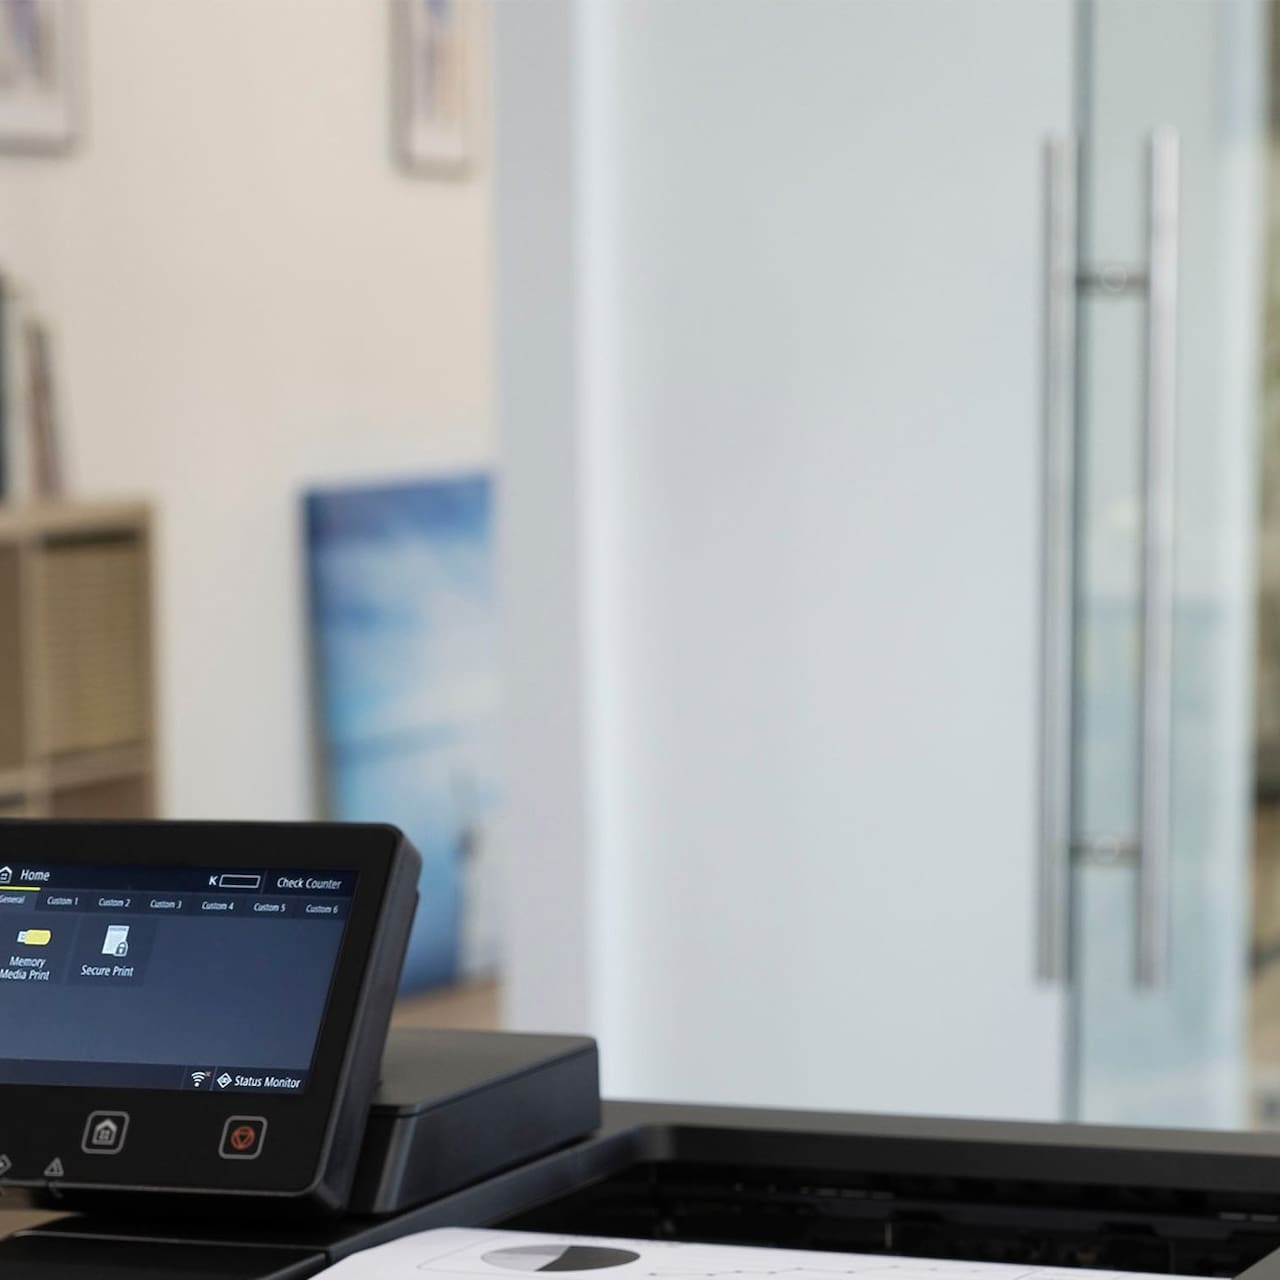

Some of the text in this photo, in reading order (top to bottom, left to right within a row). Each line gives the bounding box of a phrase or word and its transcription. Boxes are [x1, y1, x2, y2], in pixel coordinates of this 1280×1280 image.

[20, 869, 50, 882] Home
[276, 877, 342, 890] Check Counter
[47, 896, 72, 905] Custom
[98, 898, 131, 908] Custom 2
[150, 899, 182, 909] Custom 3
[201, 901, 234, 911] Custom 4
[253, 903, 286, 913] Custom 5
[305, 904, 338, 914] Custom 6
[9, 956, 46, 969] Memory
[0, 969, 50, 981] Media Print
[81, 964, 134, 977] Secure Print
[234, 1075, 301, 1089] Status Monitor
